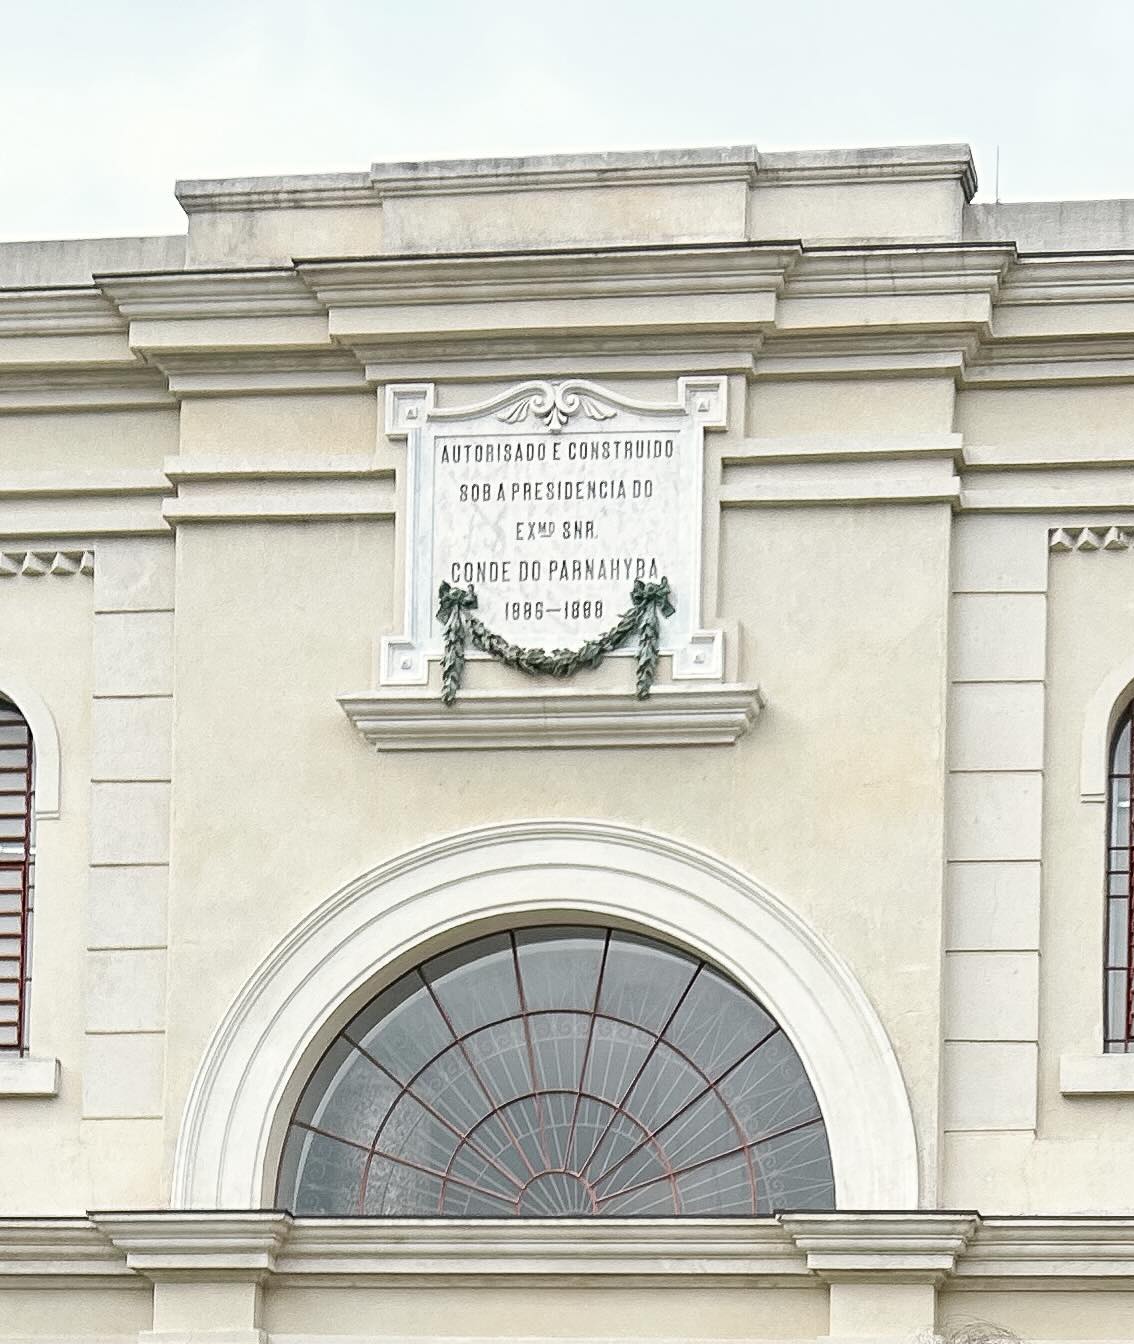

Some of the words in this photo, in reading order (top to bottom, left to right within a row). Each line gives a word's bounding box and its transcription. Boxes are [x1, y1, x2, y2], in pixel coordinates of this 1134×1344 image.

[441, 443, 545, 463] AUTORISADO
[553, 442, 562, 461] E
[568, 440, 673, 460] CONSTRUIDO
[459, 484, 491, 502] SOB
[497, 483, 506, 501] A
[511, 480, 627, 500] PRESIDENCIA
[633, 479, 653, 498] DO
[451, 561, 511, 584] CONDE
[519, 560, 541, 582] DO
[549, 557, 660, 582] PARNAHYBA
